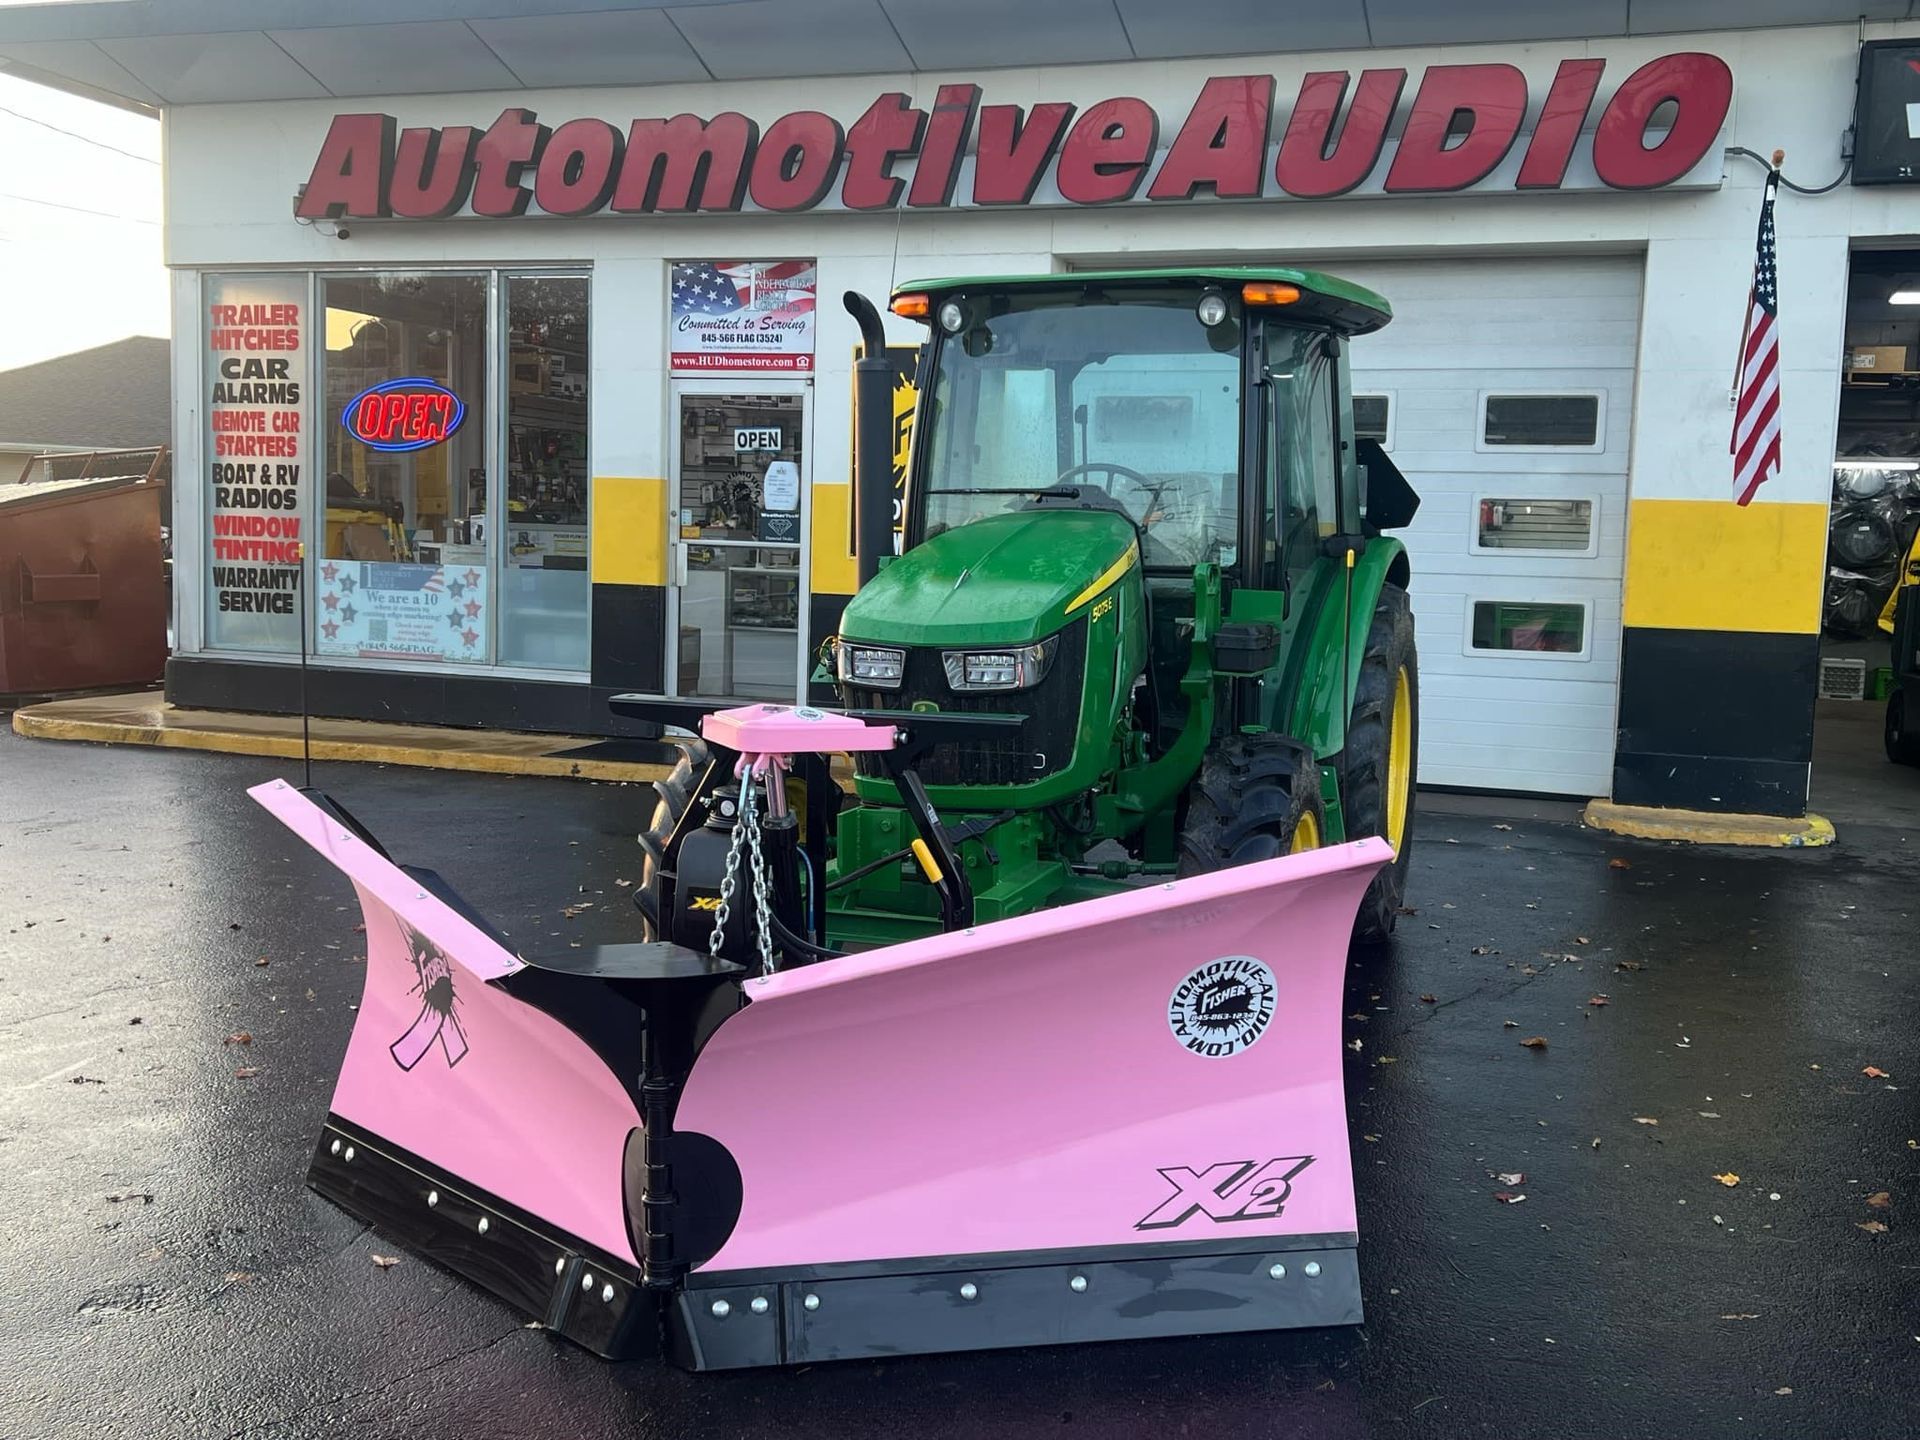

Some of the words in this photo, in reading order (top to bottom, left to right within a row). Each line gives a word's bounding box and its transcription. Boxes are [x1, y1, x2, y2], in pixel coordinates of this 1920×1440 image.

[211, 304, 299, 326] TRAILER
[678, 315, 741, 332] Committed
[745, 318, 755, 329] to
[760, 316, 806, 335] Serving
[211, 329, 299, 350] HITCHES
[701, 333, 735, 343] 845-566
[737, 334, 755, 343] FLAG
[756, 334, 783, 343] (3524)
[221, 358, 289, 379] CAR
[673, 356, 793, 367] www.HUDhomestore.com
[212, 383, 300, 404] ALARMS
[212, 411, 265, 432] REMOTE
[272, 411, 300, 433] CAR
[357, 394, 451, 441] OPEN
[215, 435, 297, 457] STARTERS
[737, 431, 779, 448] OPEN
[212, 463, 256, 484] BOAT
[260, 464, 272, 485] &
[276, 465, 299, 485] RV
[216, 487, 297, 510] RADIOS
[213, 515, 300, 538] WINDOW
[213, 539, 300, 562] TINTING
[213, 567, 299, 590] WARRANTY
[219, 591, 294, 614] SERVICE
[367, 590, 385, 603] We
[388, 594, 409, 604] are
[413, 596, 420, 604] a
[424, 593, 439, 605] 10
[1200, 985, 1248, 1014] FISHER
